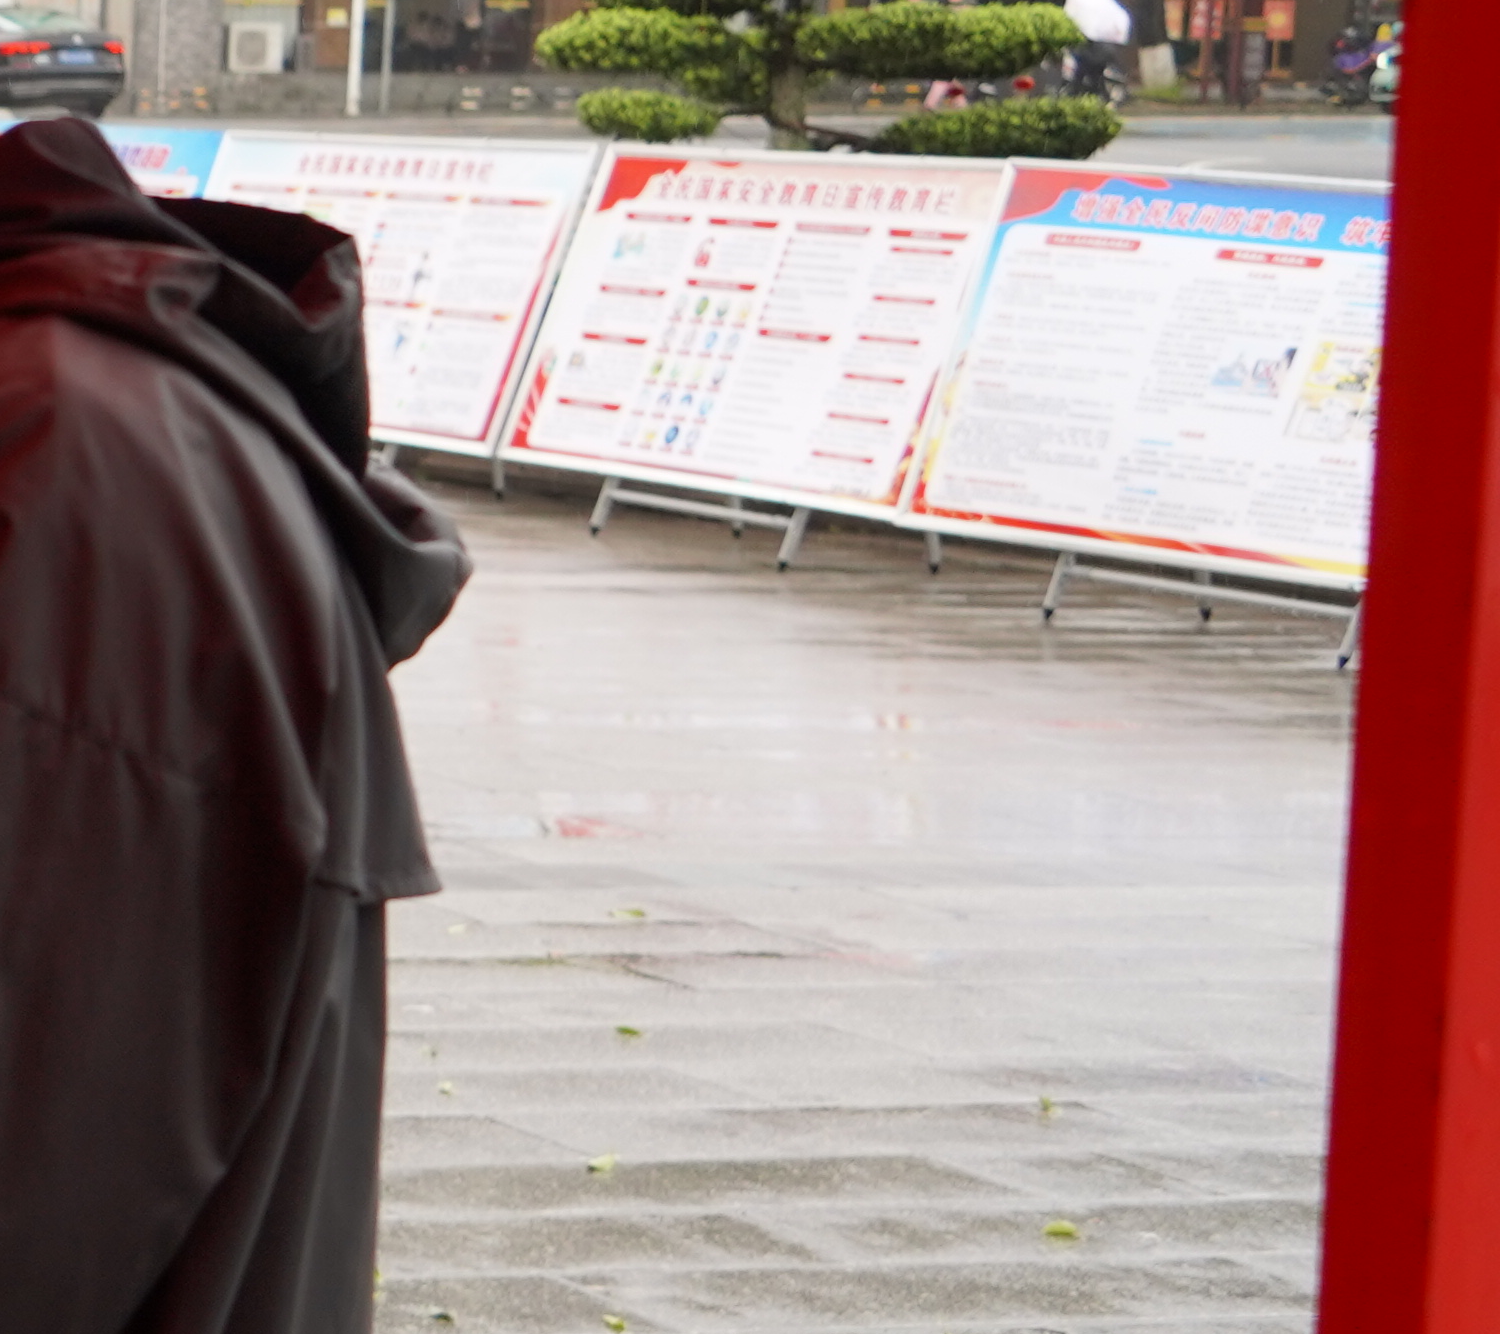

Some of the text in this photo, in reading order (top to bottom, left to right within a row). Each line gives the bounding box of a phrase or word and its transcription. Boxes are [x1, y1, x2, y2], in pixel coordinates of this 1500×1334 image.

[654, 171, 958, 215] 全民国家安全教育日宣传教育栏
